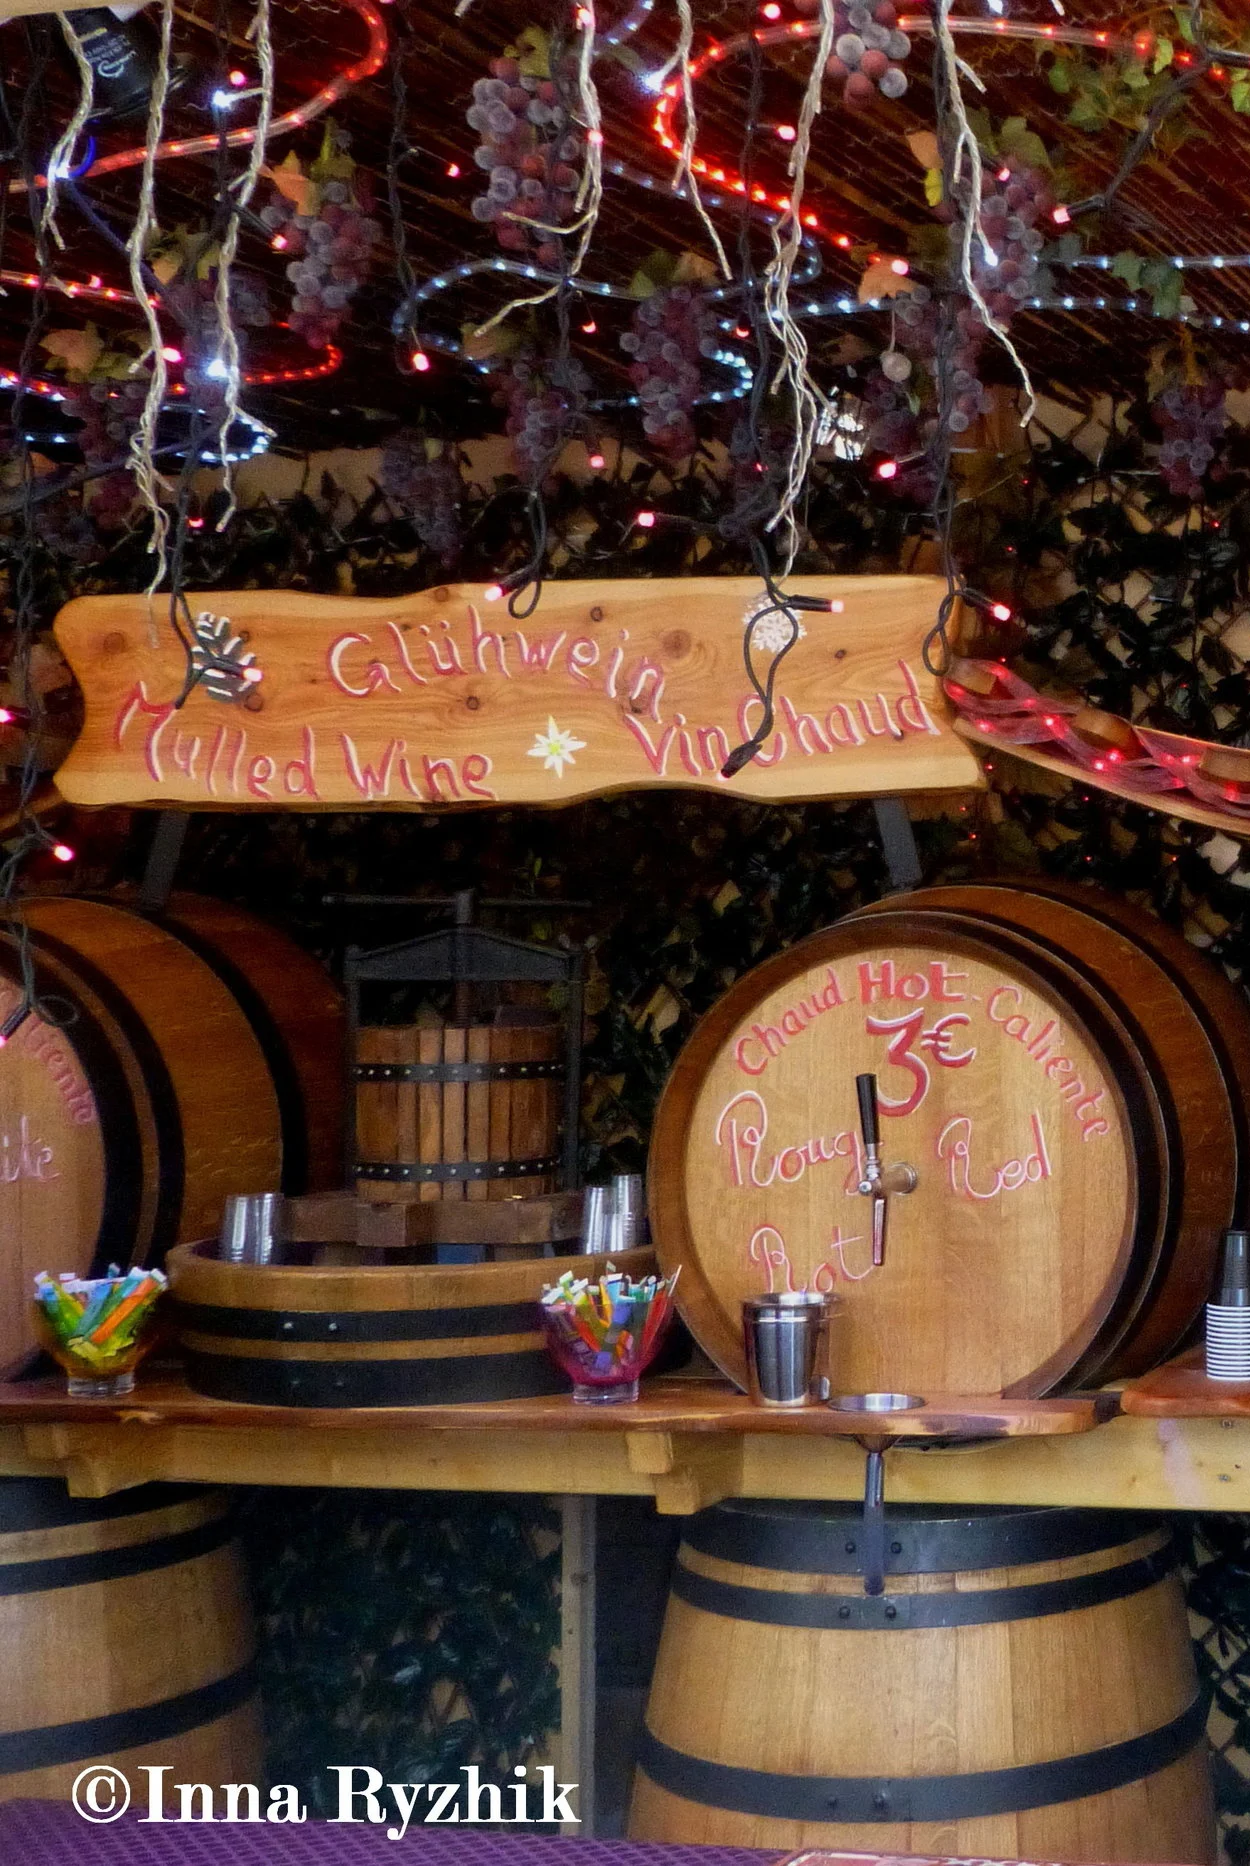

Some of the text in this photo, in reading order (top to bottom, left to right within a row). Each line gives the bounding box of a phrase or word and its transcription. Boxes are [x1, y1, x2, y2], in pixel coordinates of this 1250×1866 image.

[329, 604, 664, 722] Glühwein
[623, 657, 941, 777] Vin Chaud
[113, 680, 499, 801] Mulled Wine
[734, 967, 846, 1076] Chaud
[985, 984, 1110, 1143] Caliente
[935, 1108, 1052, 1200] Red
[750, 1223, 878, 1294] Rot
